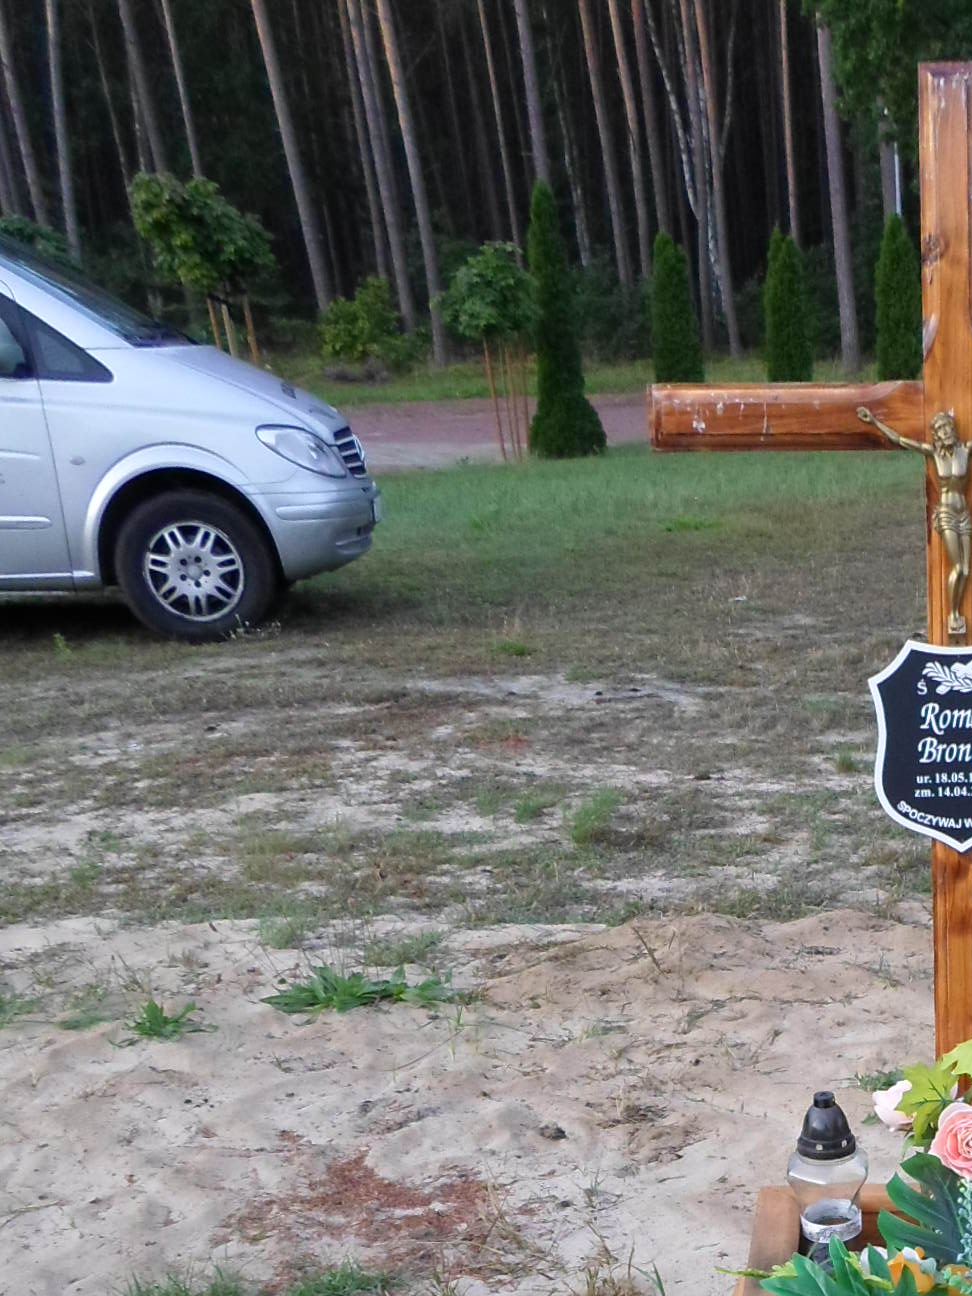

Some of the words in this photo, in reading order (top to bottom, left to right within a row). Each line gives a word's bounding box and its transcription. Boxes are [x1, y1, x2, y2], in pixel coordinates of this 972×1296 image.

[916, 678, 928, 695] Ś
[916, 775, 932, 784] ur.
[914, 789, 935, 798] zm.
[896, 800, 962, 829] SPOCZYWAJ
